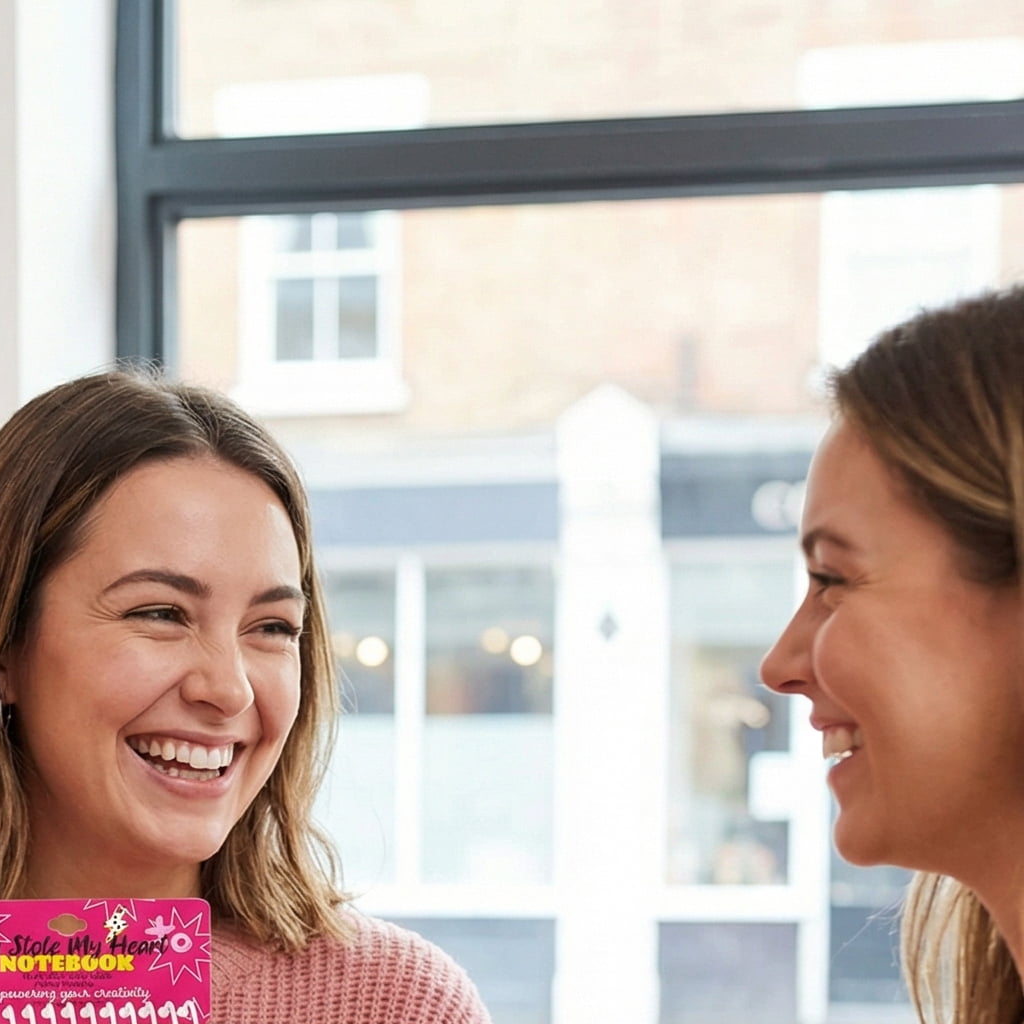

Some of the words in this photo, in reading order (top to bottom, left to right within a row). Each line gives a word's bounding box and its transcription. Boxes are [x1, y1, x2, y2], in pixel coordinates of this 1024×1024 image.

[8, 935, 60, 958] Stole
[68, 935, 103, 960] My
[109, 934, 169, 957] Heart
[0, 954, 135, 973] NOTEBOOK
